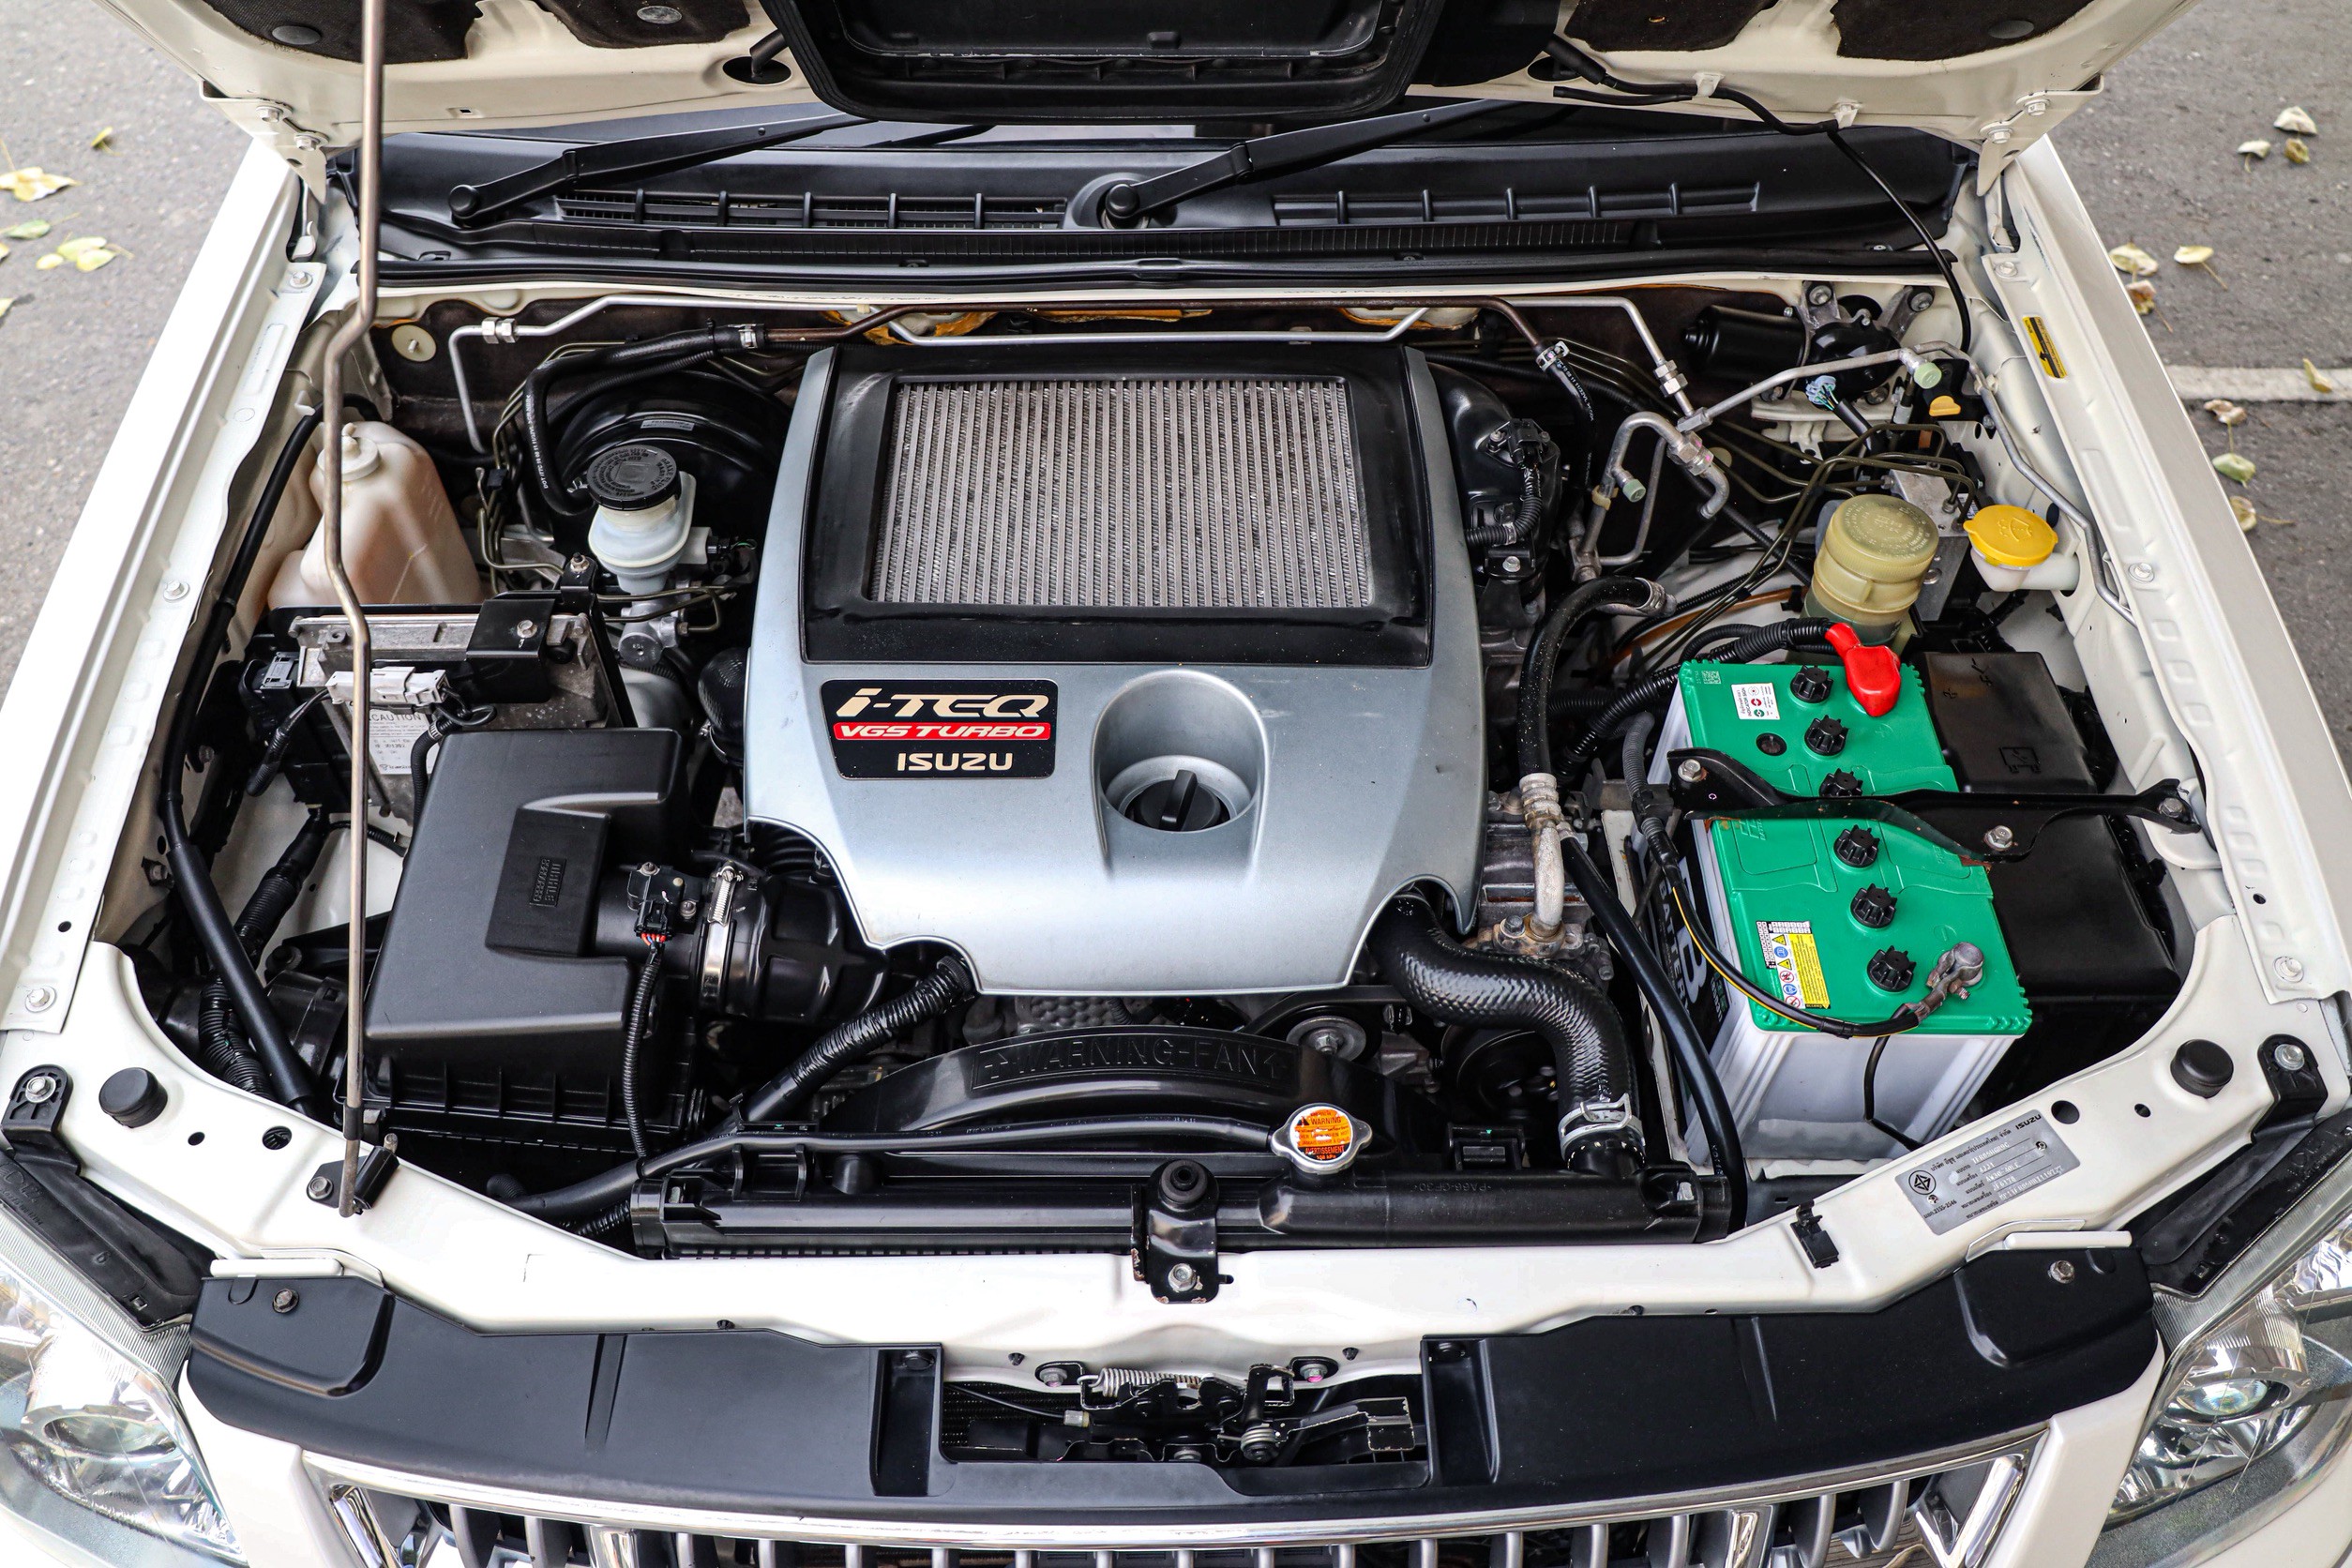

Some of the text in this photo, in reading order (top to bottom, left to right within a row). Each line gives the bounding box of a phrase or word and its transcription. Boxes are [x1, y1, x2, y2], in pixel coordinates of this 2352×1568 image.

[370, 713, 422, 721] CAUTION
[840, 725, 1045, 737] VGS TURBO
[897, 752, 1013, 771] ISUZU
[1310, 1116, 1342, 1125] WARNING
[2015, 1114, 2042, 1130] ISUZU
